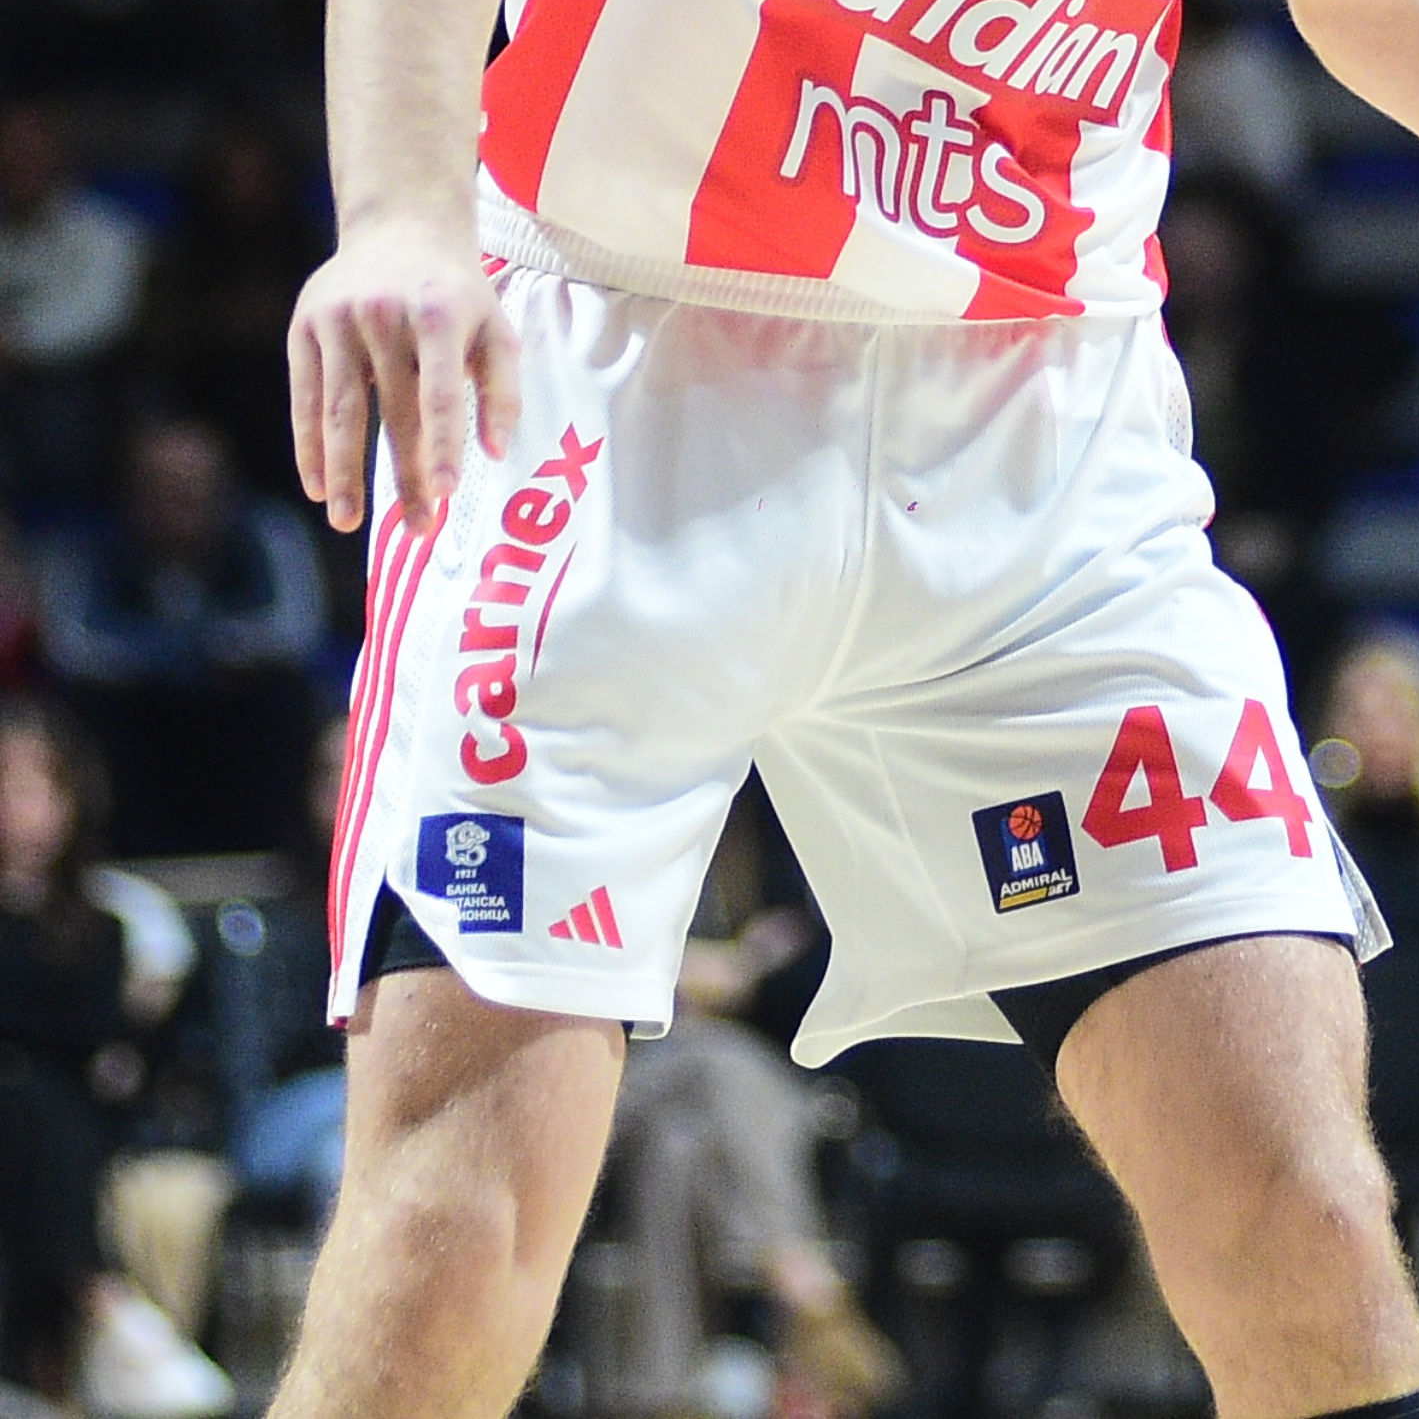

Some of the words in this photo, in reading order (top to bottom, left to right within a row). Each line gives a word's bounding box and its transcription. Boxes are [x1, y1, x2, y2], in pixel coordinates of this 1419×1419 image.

[779, 75, 1048, 244] mts
[454, 421, 605, 786] carnex
[1081, 697, 1313, 873] 44
[455, 896, 506, 908] ТАНСКА
[1001, 867, 1073, 898] ADMIRAL
[1011, 841, 1045, 872] ABA
